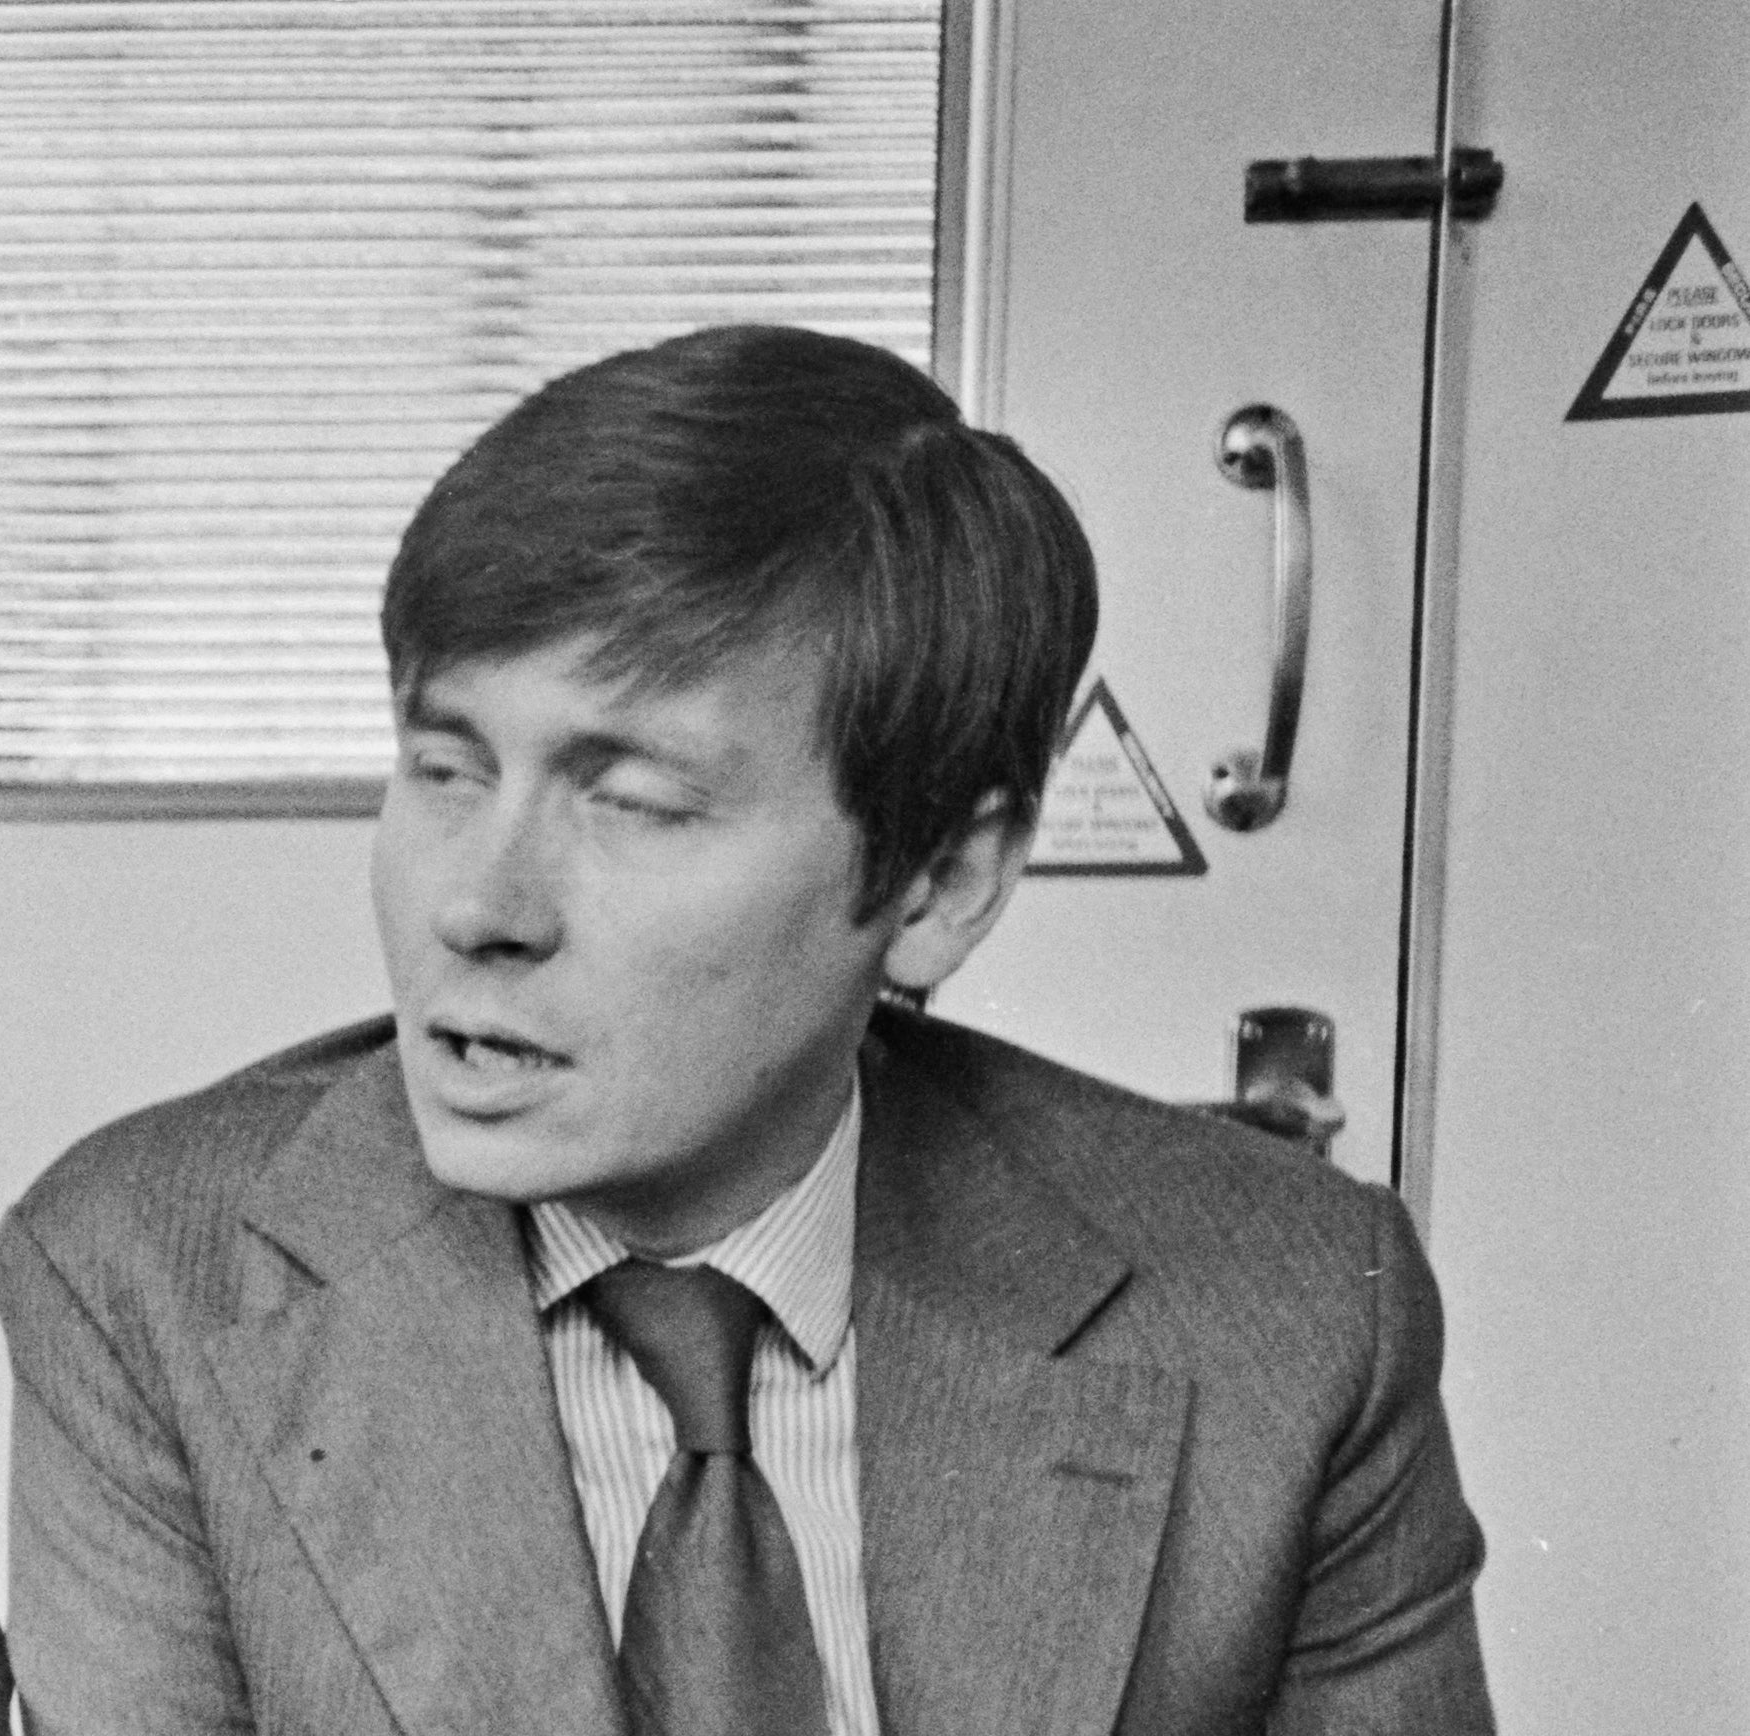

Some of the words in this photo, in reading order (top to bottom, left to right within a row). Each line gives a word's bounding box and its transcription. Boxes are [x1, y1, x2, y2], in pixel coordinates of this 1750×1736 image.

[1667, 286, 1718, 305] PLEASE
[1649, 317, 1685, 331] LOCK
[1692, 313, 1740, 329] DOORS
[1628, 352, 1681, 368] SECURE
[1647, 371, 1687, 386] before
[1692, 370, 1739, 384] leaving
